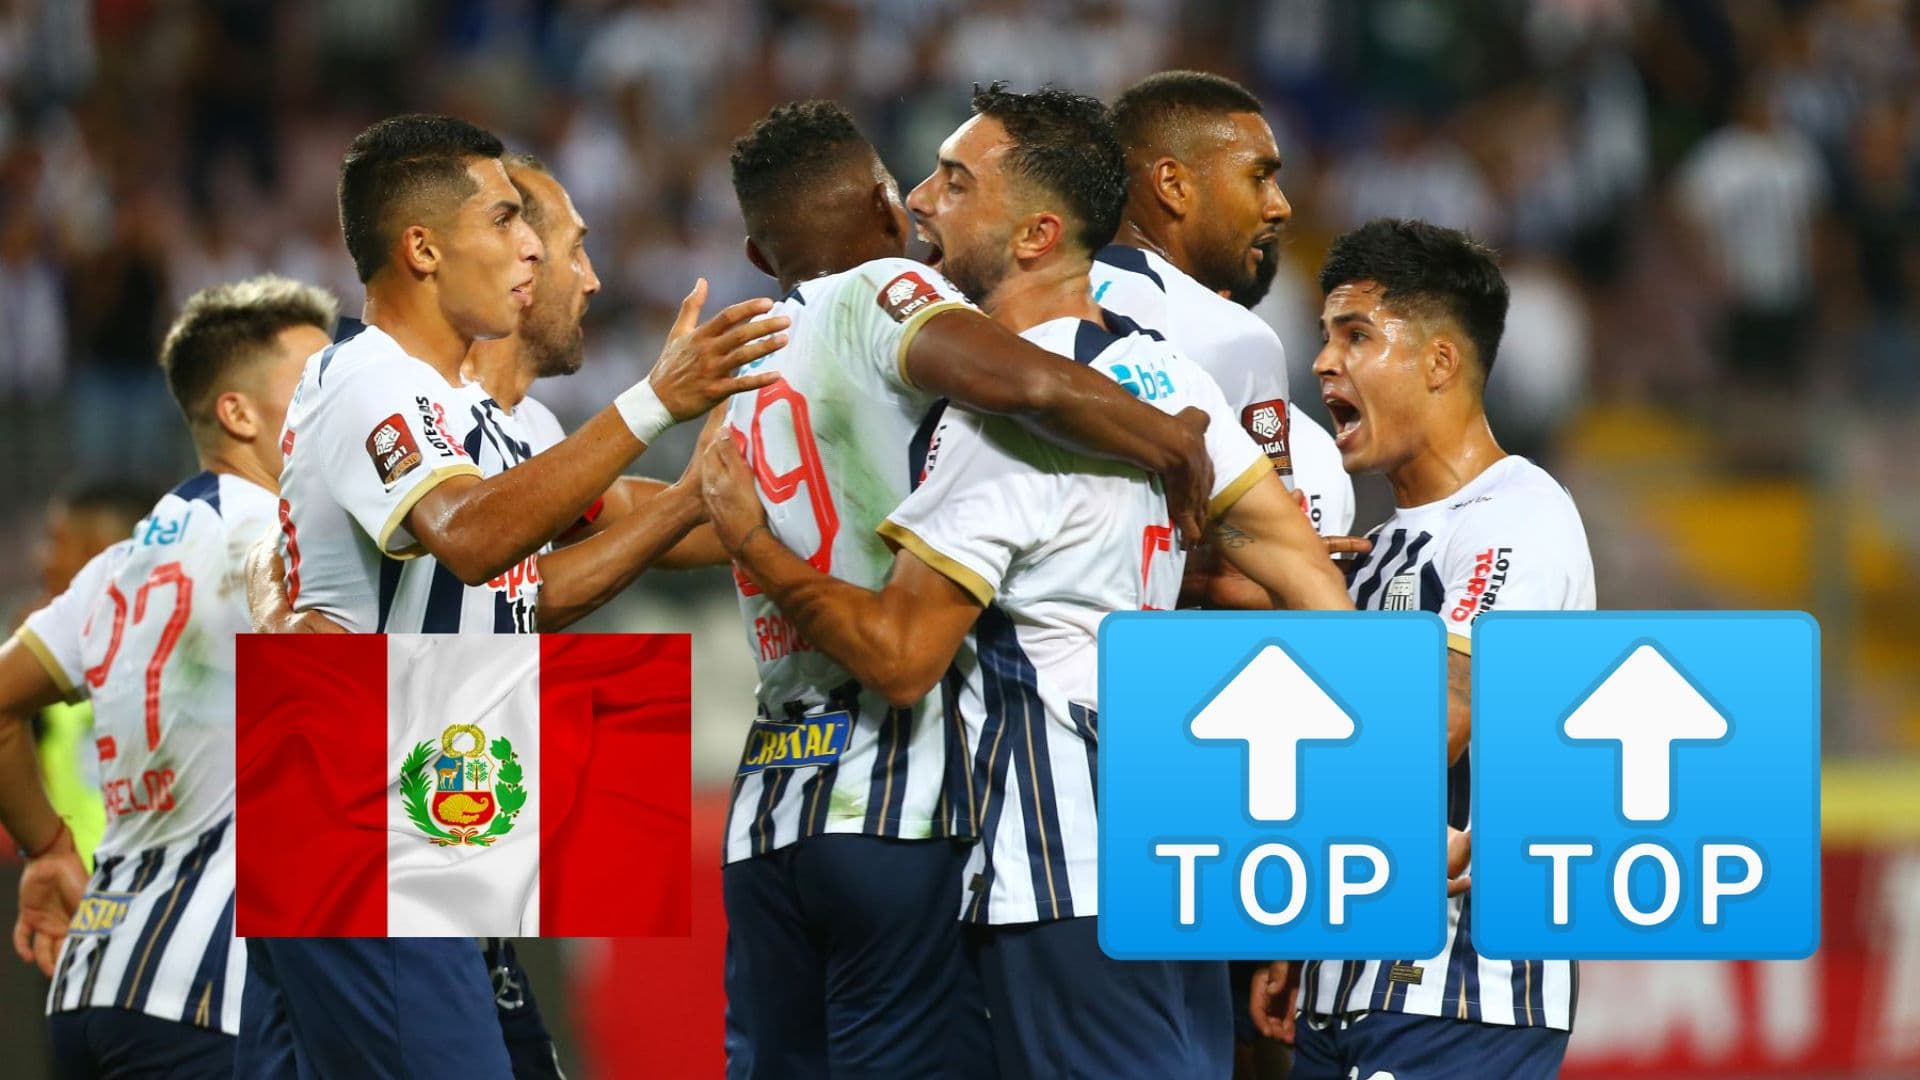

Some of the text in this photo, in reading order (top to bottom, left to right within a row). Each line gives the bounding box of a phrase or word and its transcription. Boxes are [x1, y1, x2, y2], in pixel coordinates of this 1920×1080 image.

[383, 445, 408, 471] LIGA1
[1264, 440, 1286, 454] IGA1
[143, 511, 191, 546] tel
